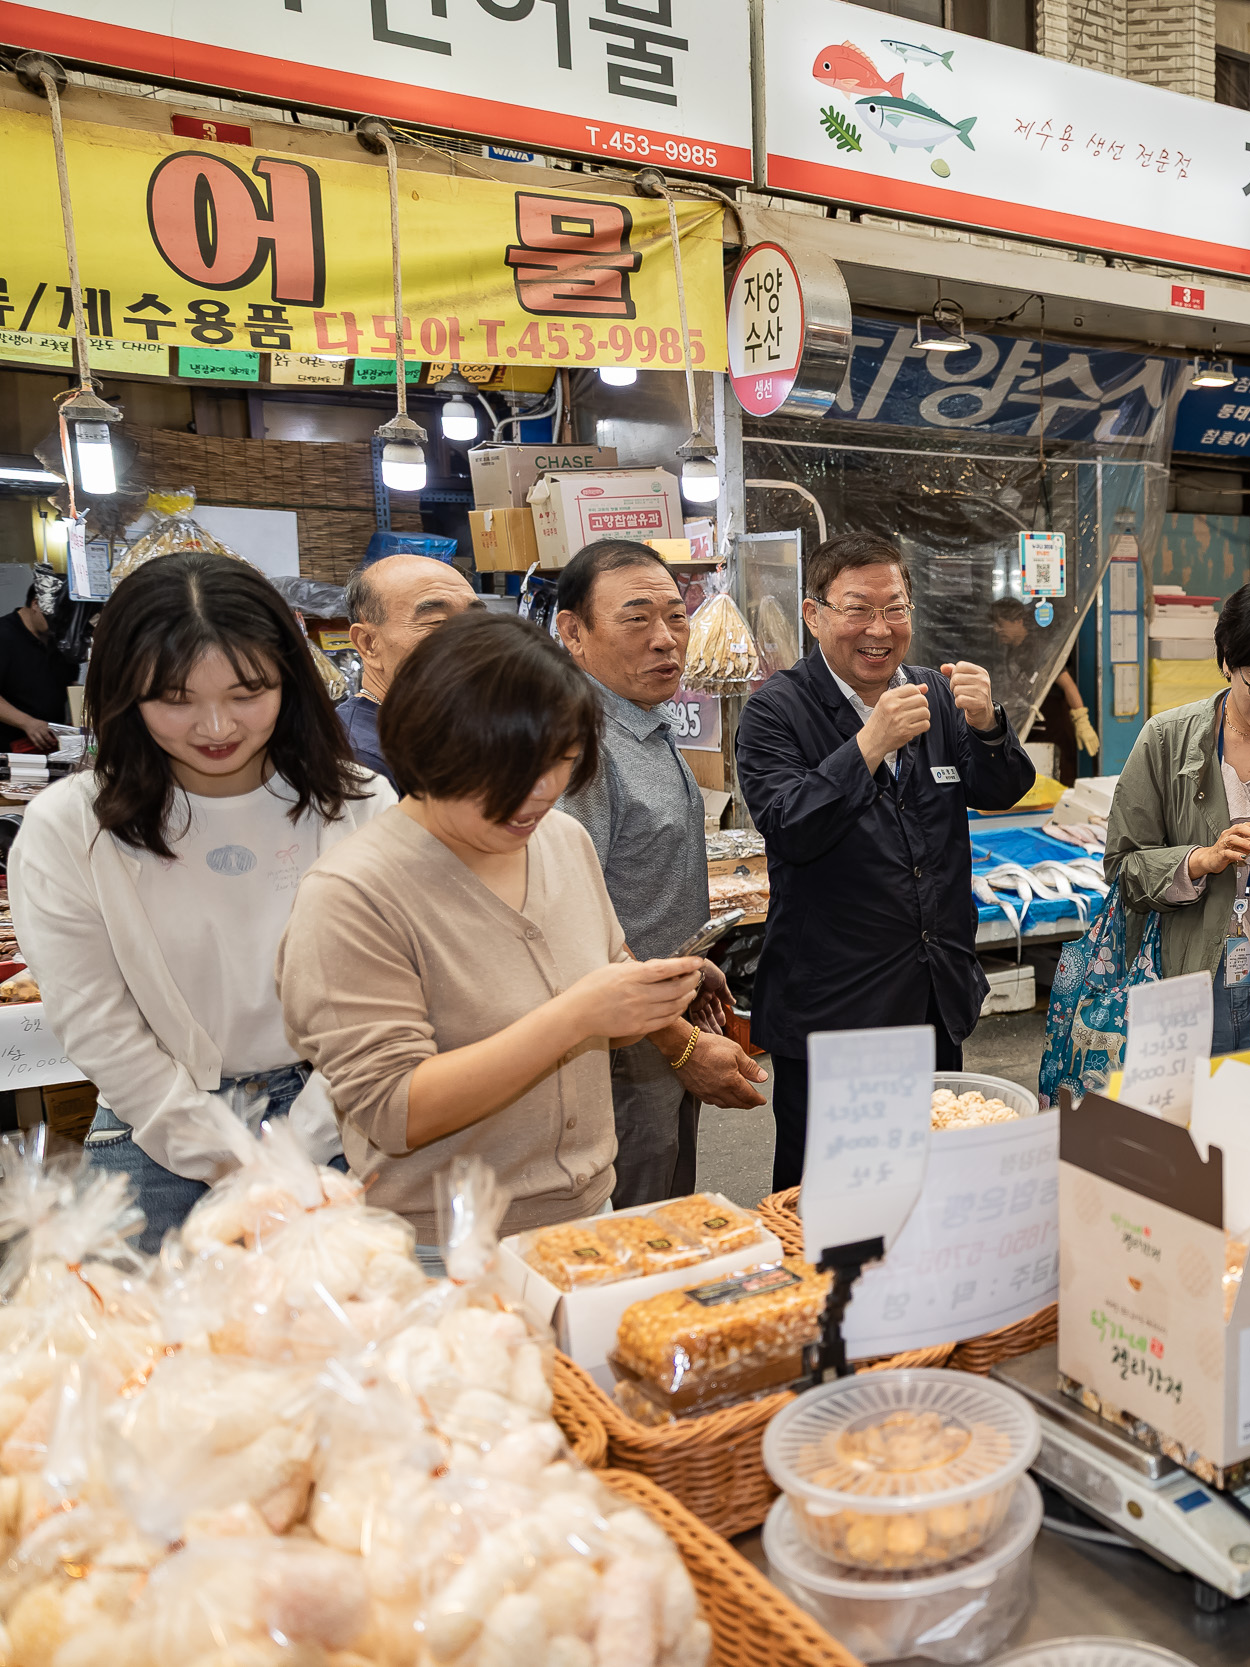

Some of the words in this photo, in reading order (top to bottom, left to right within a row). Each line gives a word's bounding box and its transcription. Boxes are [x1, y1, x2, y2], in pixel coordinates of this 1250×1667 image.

[492, 146, 530, 161] WINIA
[585, 124, 719, 170] T.453-9985
[1014, 118, 1075, 152] 제수용
[1086, 133, 1125, 161] 생선
[1136, 143, 1192, 180] 전문점
[147, 150, 326, 308] 어
[504, 190, 642, 320] 물
[744, 268, 783, 314] 자양
[1183, 288, 1191, 303] 3
[314, 311, 465, 361] 다모아
[478, 318, 706, 365] T.453-9985
[744, 316, 783, 363] 수산
[754, 378, 773, 400] 생선
[534, 455, 595, 469] CHASE
[591, 512, 660, 529] 고향찹쌀유과
